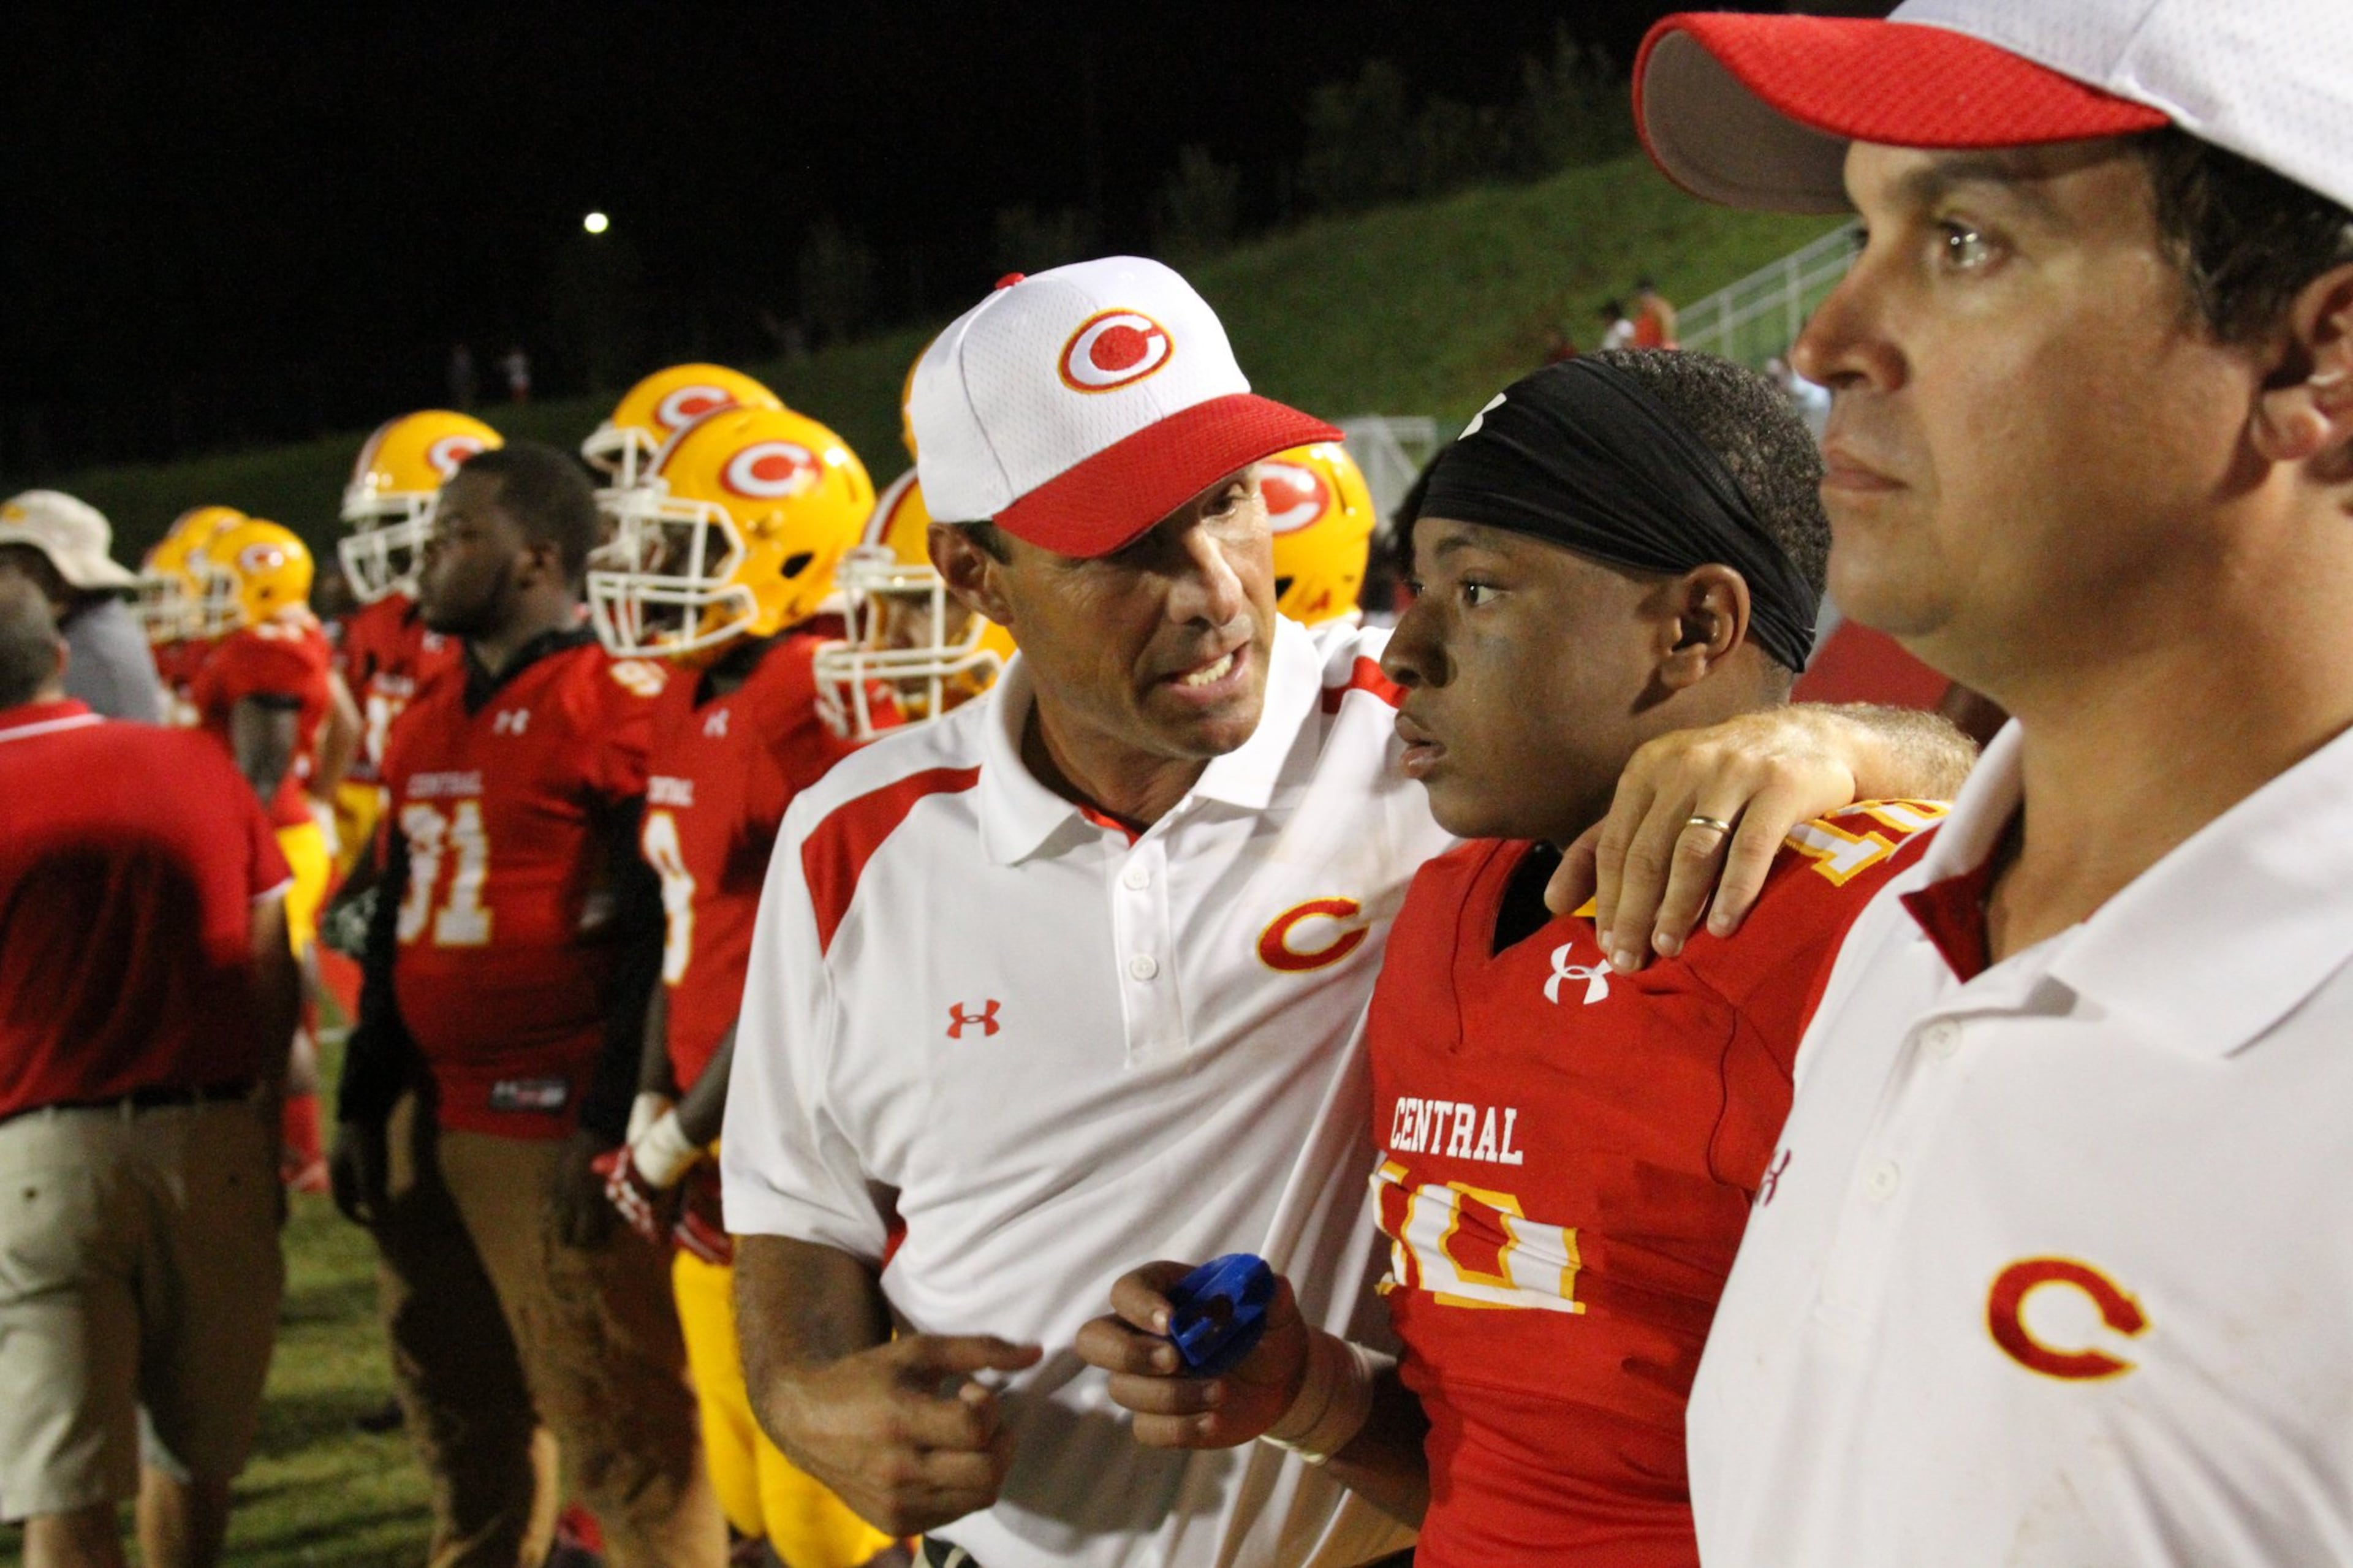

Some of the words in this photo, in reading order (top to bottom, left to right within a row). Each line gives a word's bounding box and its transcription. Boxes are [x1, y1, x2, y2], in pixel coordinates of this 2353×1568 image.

[1069, 314, 1167, 385] C
[729, 442, 812, 496] C
[1257, 896, 1371, 973] C
[1390, 1097, 1524, 1165] CENTRAL
[1985, 1254, 2152, 1382] C
